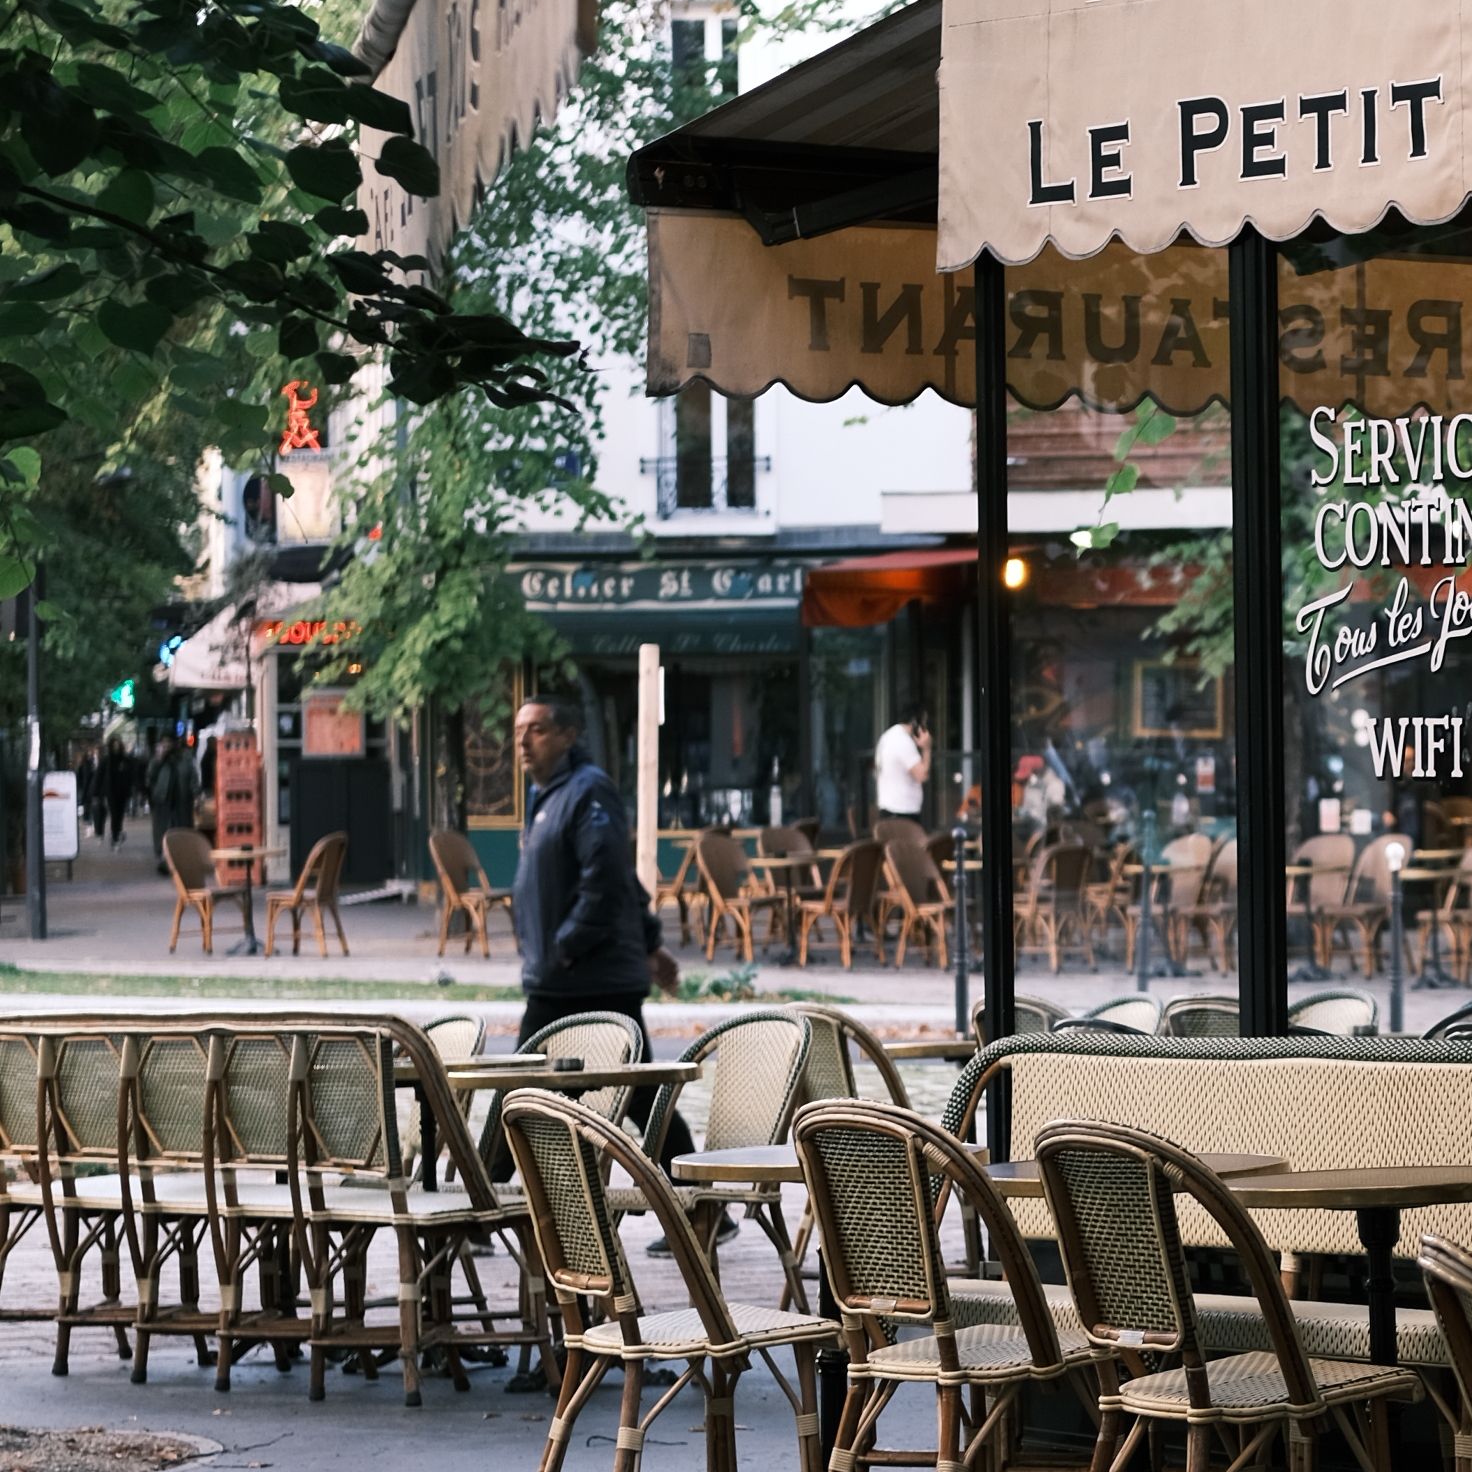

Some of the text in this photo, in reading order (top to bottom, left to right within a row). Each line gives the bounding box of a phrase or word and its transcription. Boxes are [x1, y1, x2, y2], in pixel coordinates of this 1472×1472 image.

[1027, 118, 1133, 207] LE
[1176, 75, 1443, 190] PETIT
[712, 566, 803, 597] Carl
[1296, 581, 1378, 695] Tous
[1385, 576, 1423, 646] les
[1366, 714, 1463, 778] WIFI
